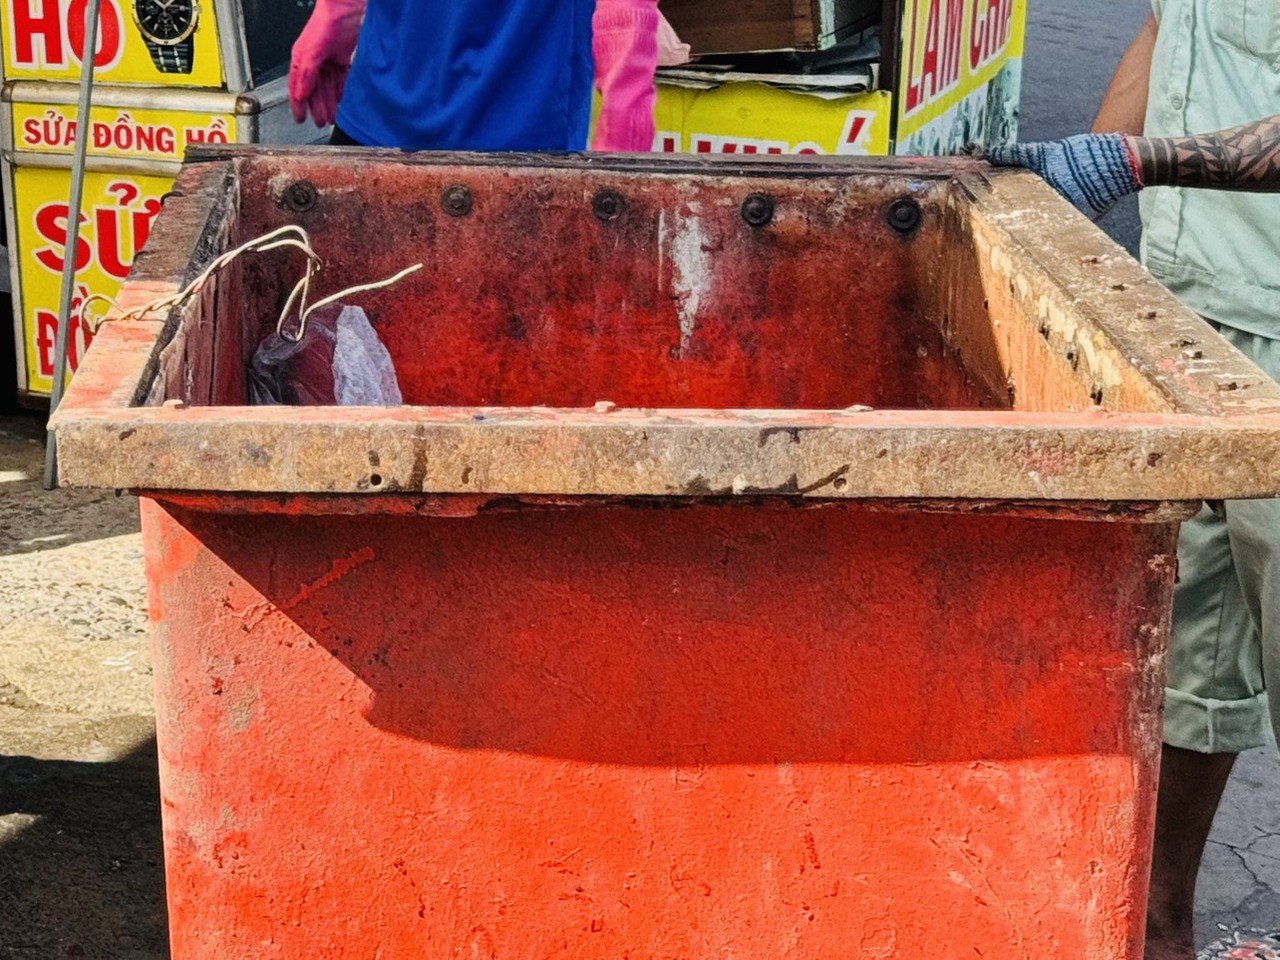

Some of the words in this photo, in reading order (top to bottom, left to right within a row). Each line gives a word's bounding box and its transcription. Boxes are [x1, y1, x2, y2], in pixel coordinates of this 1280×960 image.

[24, 110, 77, 146] SỬA
[93, 113, 174, 153] ĐỒNG
[36, 183, 161, 278] SỬ
